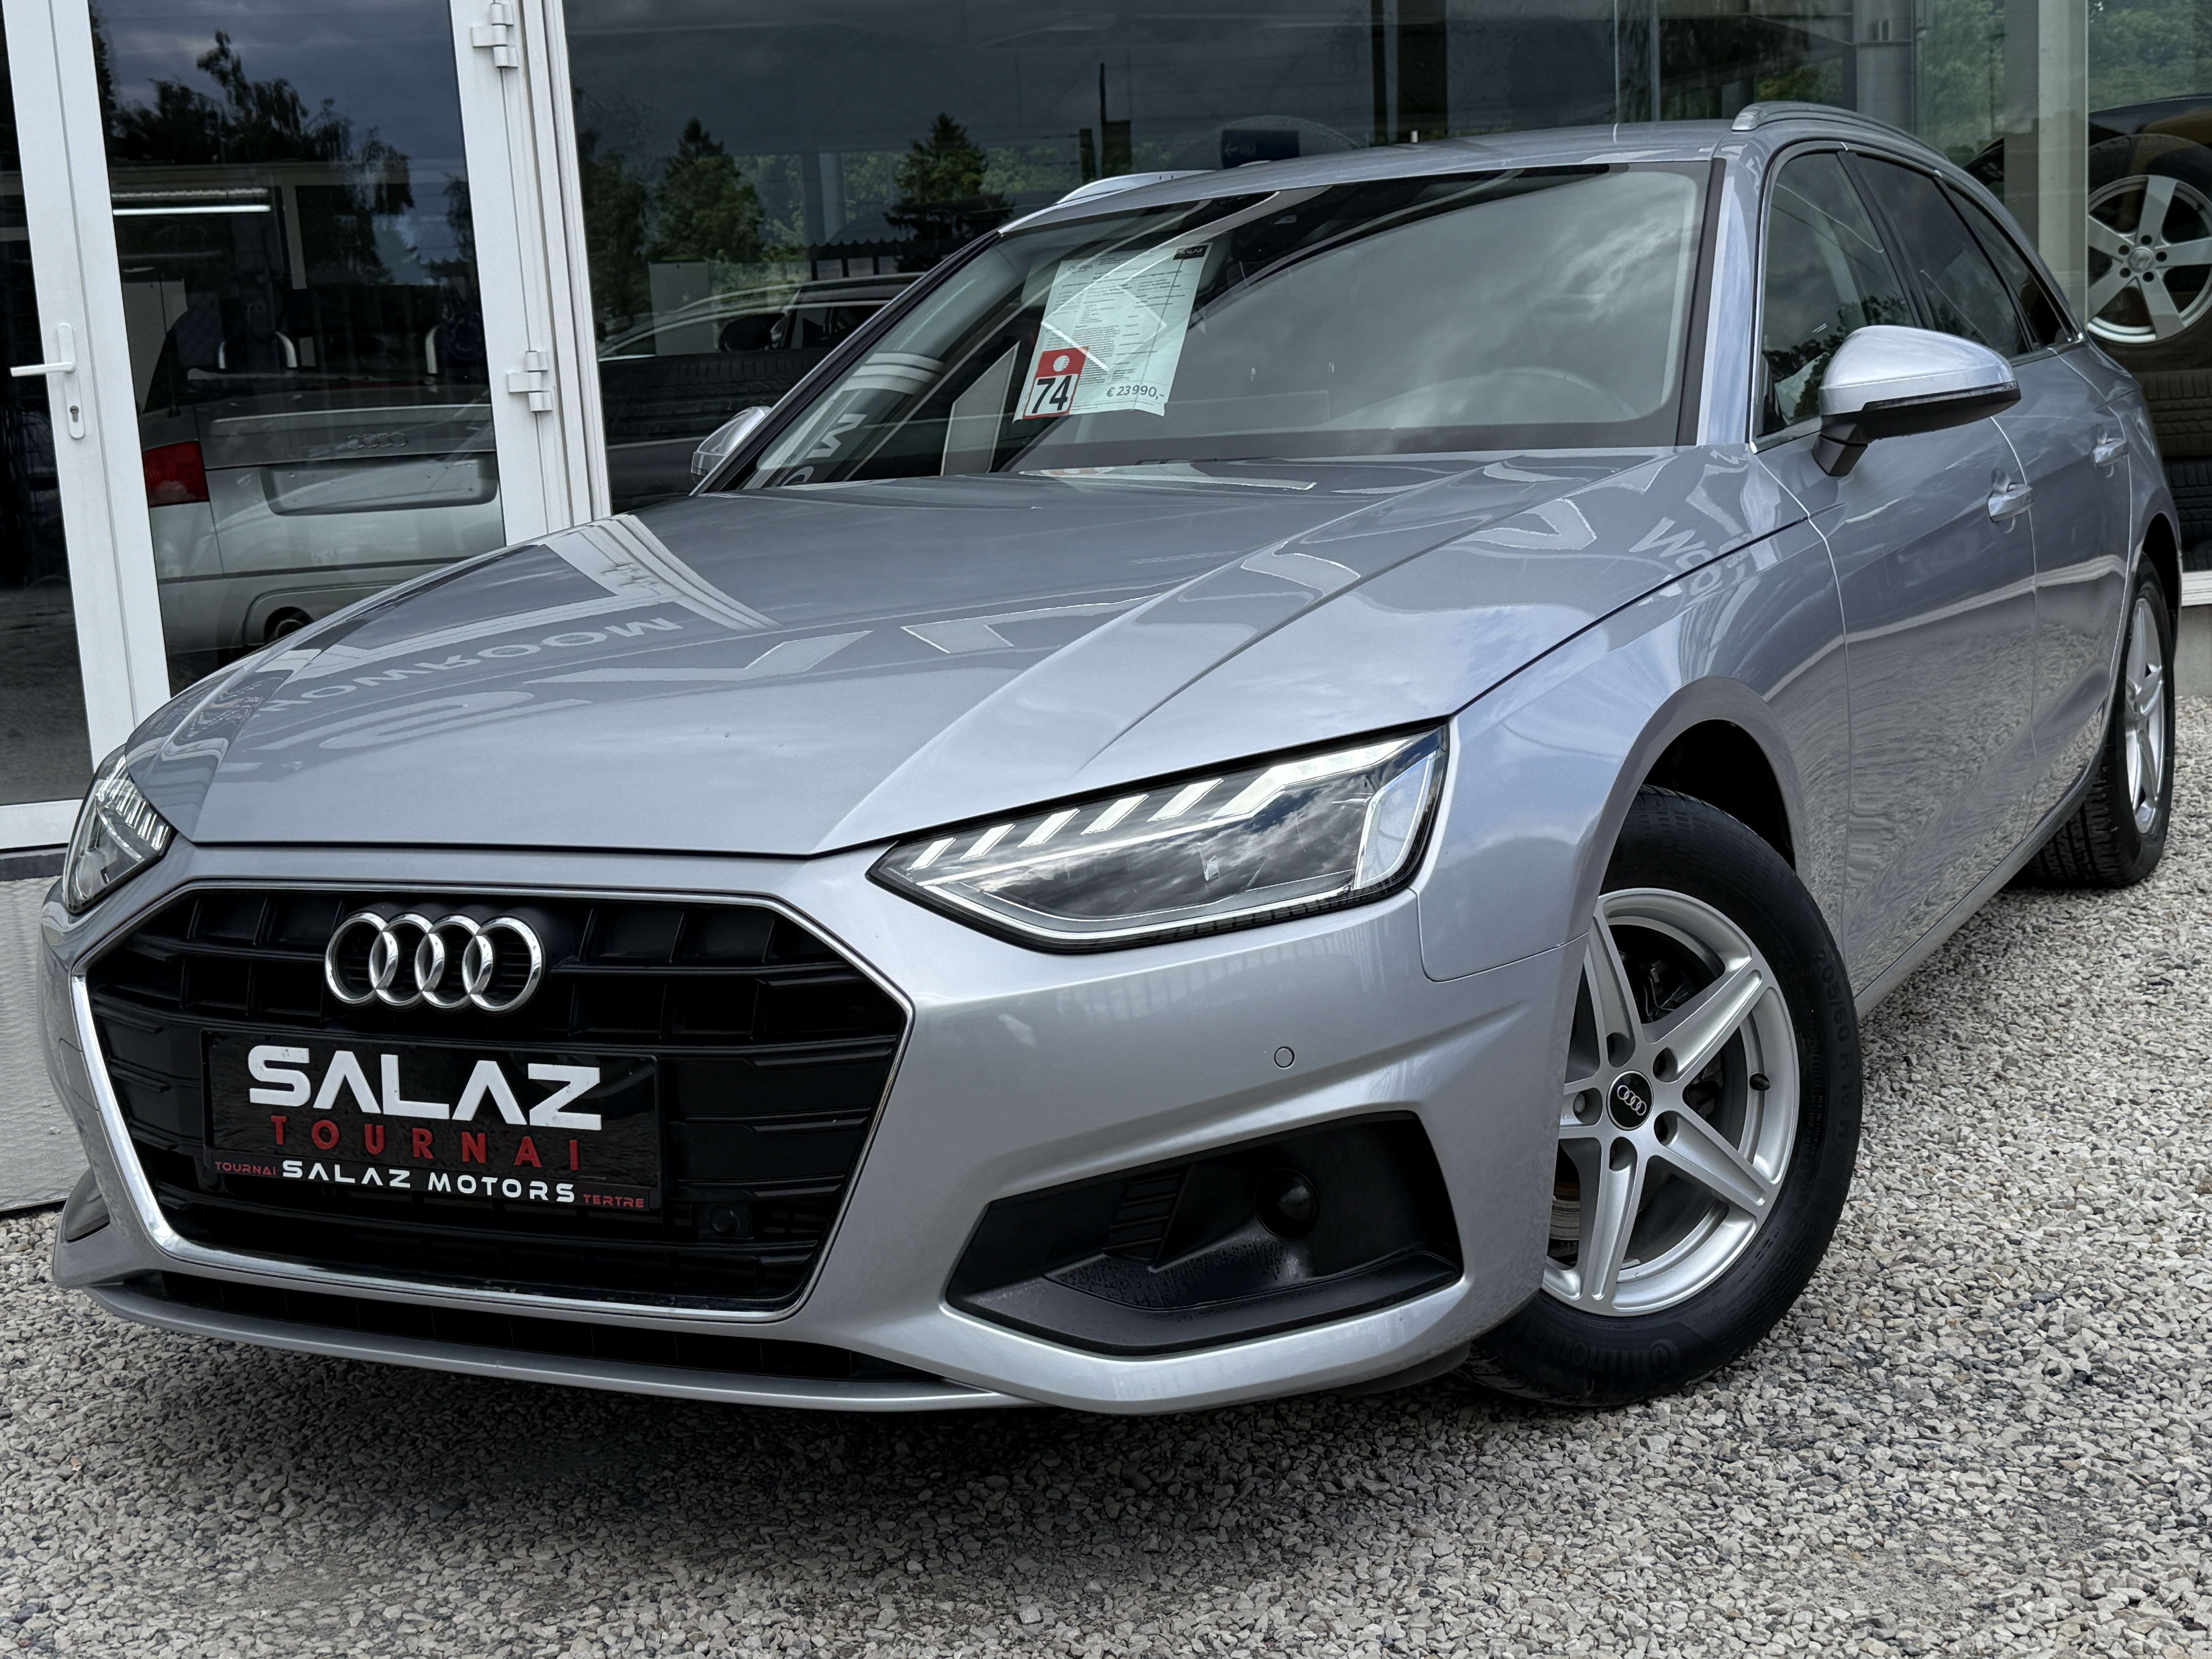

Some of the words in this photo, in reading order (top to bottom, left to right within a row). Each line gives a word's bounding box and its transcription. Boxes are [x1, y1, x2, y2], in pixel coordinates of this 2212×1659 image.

[1031, 375, 1072, 414] 74
[1106, 387, 1115, 397] €
[247, 1044, 602, 1131] SALAZ
[270, 1115, 580, 1171] TOURNAI
[215, 1161, 277, 1176] TOURNAI
[282, 1159, 411, 1189] SALAZ
[428, 1173, 575, 1203] MOTORS
[583, 1193, 645, 1209] TERTRE
